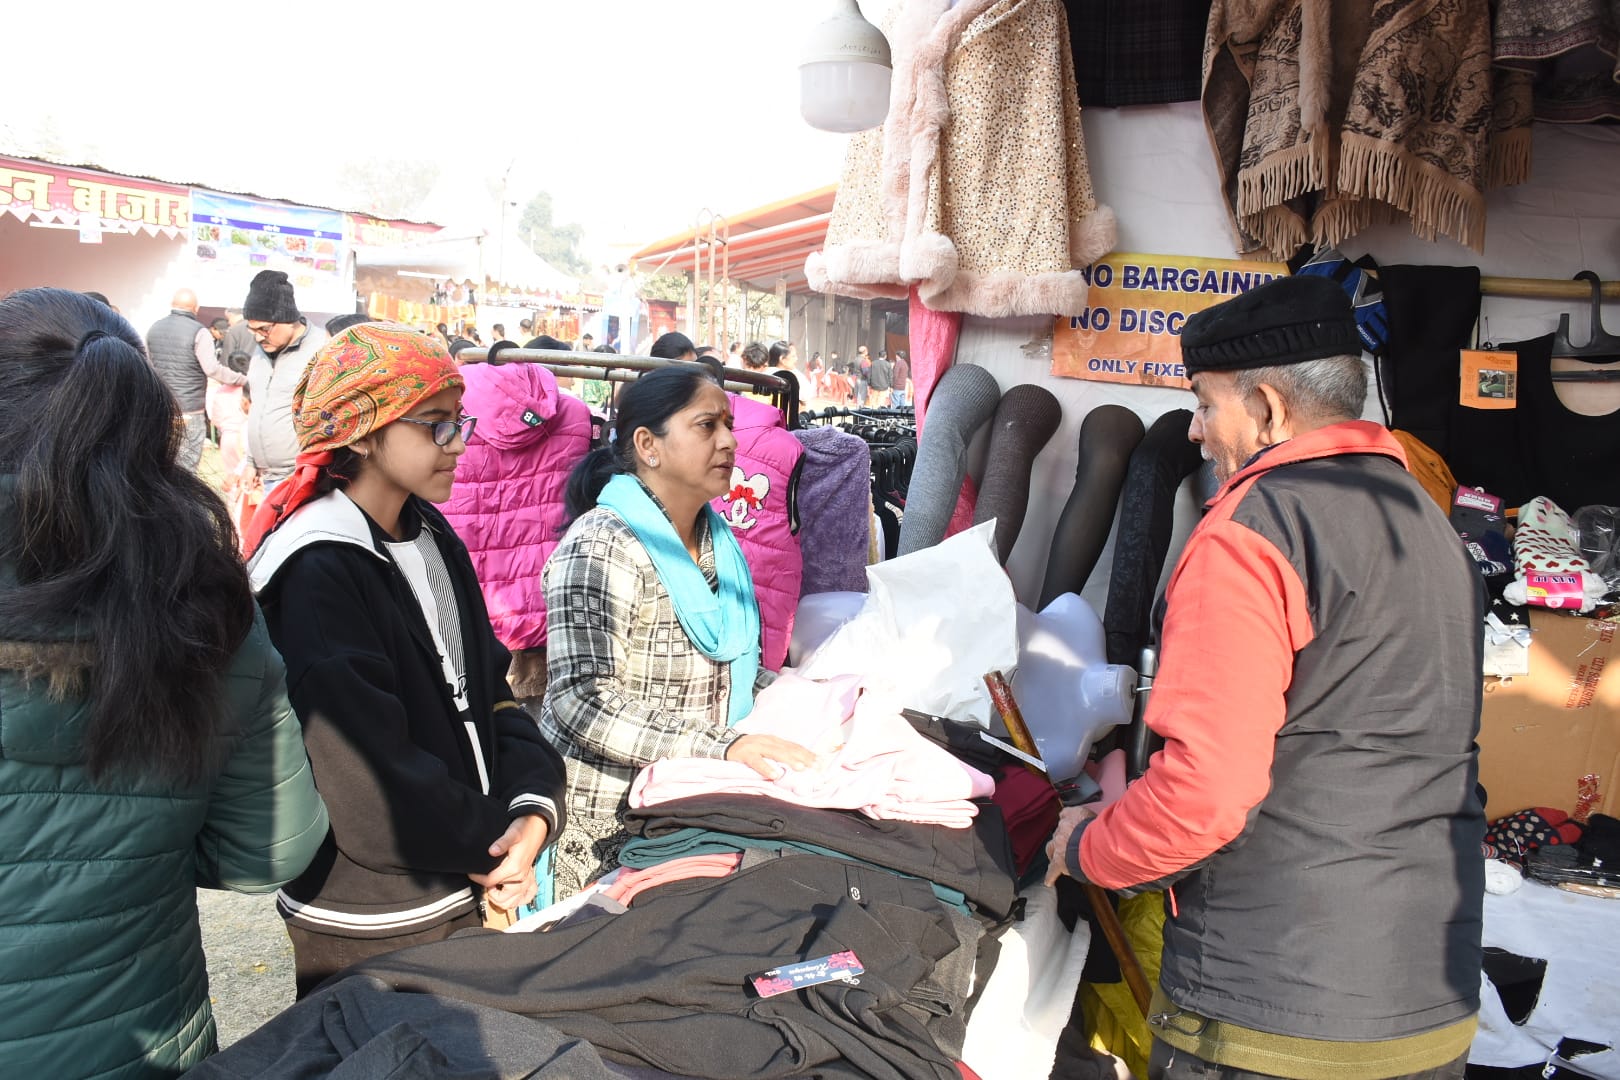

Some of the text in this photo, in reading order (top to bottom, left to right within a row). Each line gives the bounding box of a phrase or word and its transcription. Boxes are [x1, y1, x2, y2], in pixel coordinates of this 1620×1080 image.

[1081, 264, 1113, 288] NO
[1071, 307, 1195, 336] NO DISC
[1088, 358, 1137, 374] ONLY
